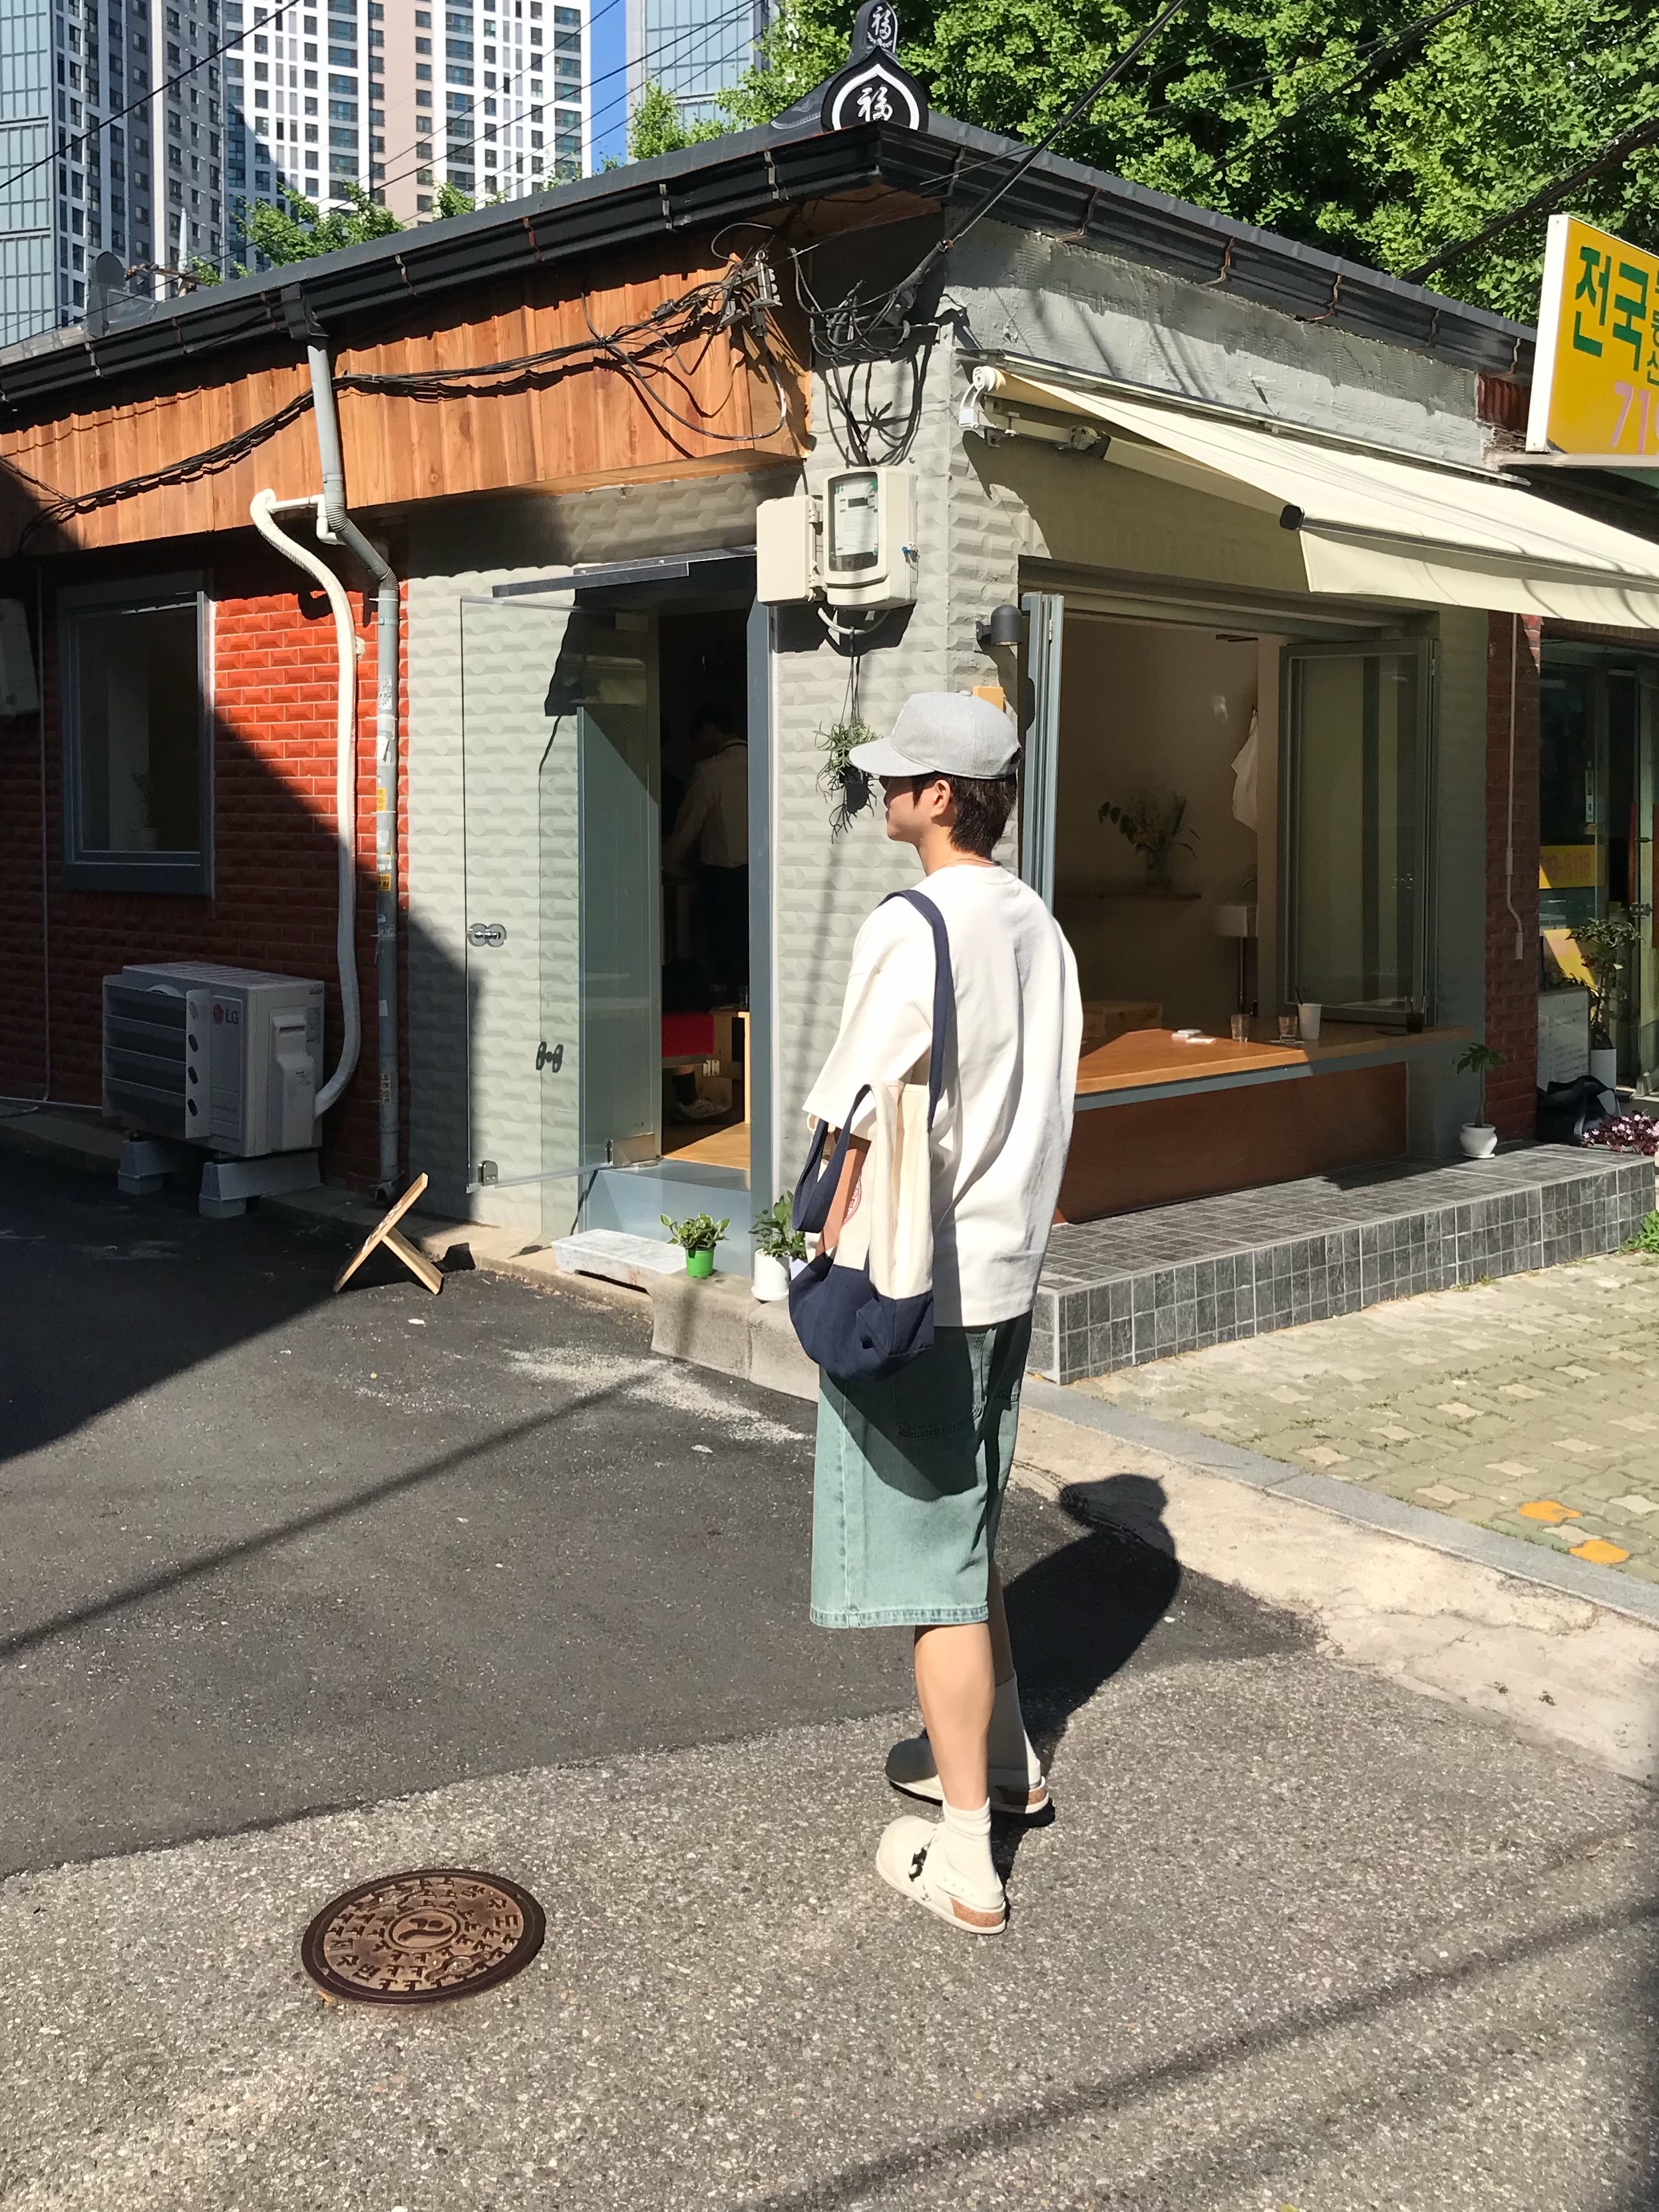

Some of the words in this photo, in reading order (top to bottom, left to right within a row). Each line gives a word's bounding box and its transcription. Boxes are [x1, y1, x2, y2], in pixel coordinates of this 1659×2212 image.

[856, 87, 893, 122] 福
[1573, 246, 1649, 372] 전국
[1610, 380, 1659, 456] 71
[226, 1009, 240, 1025] LG
